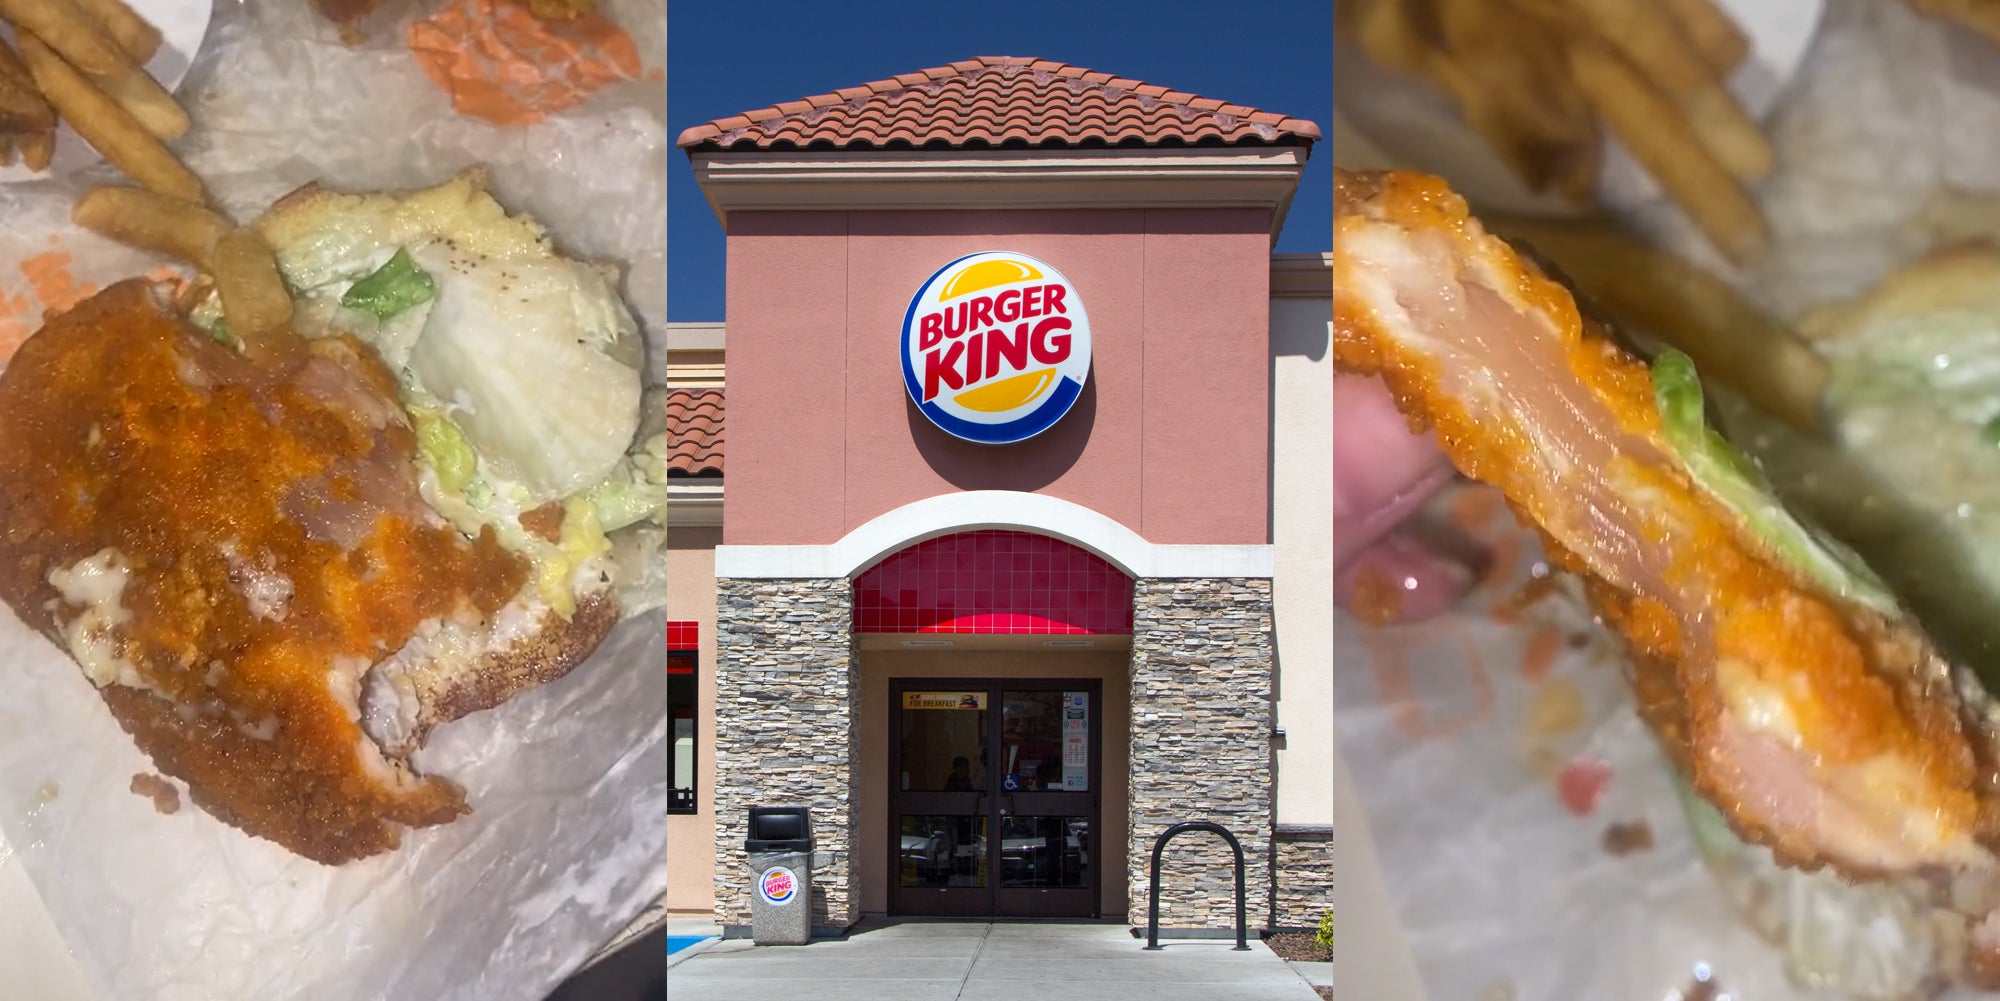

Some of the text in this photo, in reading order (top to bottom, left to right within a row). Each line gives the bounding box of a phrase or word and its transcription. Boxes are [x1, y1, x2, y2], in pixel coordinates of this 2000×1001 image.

[919, 284, 1067, 352] BURGER
[924, 316, 1072, 402] KING
[766, 876, 790, 887] BURGER
[767, 881, 791, 894] KING
